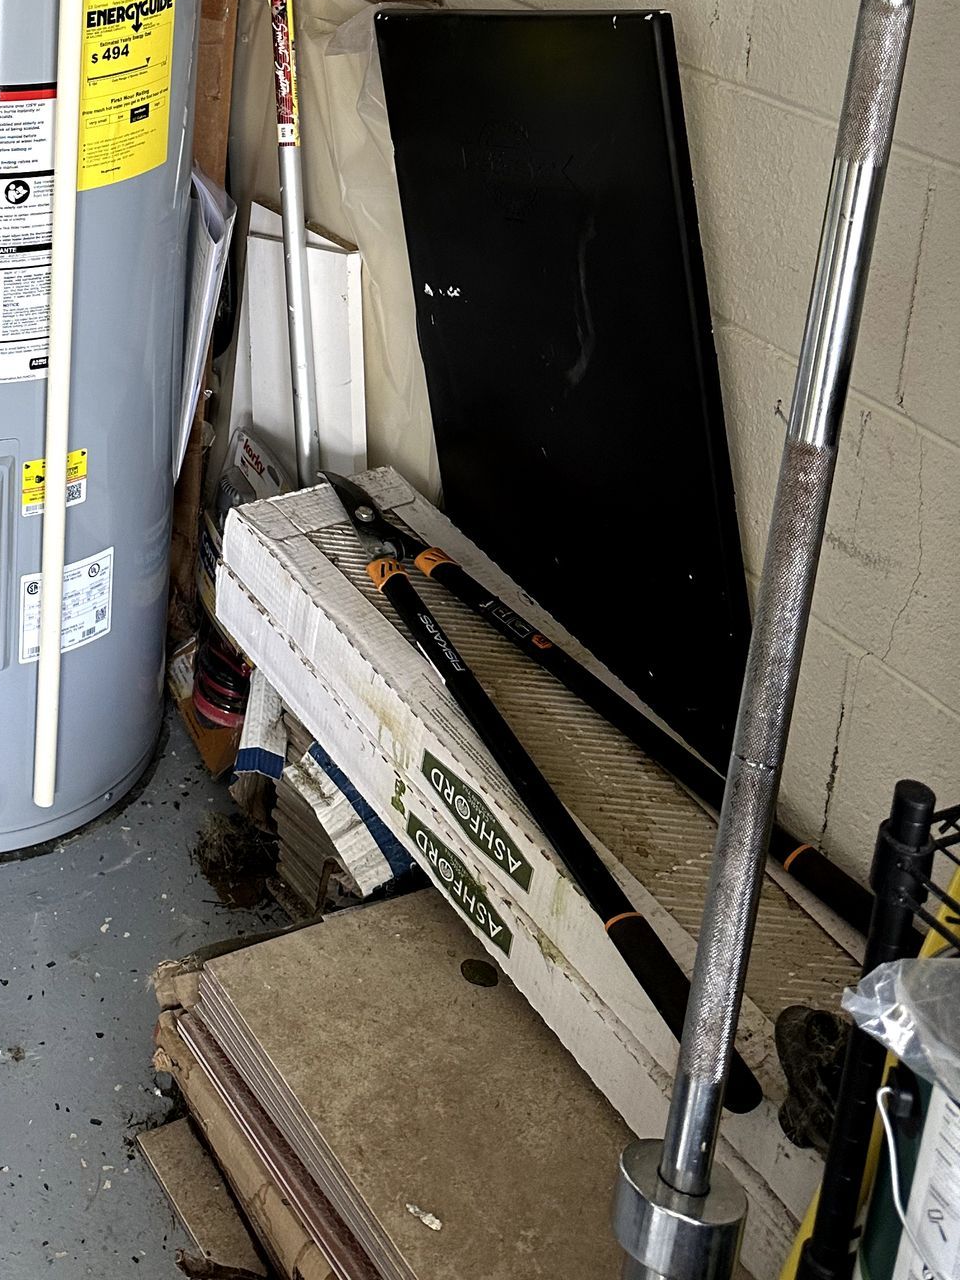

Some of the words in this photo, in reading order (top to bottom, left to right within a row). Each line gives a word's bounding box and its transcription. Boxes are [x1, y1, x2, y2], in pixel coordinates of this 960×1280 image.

[102, 43, 130, 61] 494
[419, 614, 466, 672] FISKARS
[431, 768, 522, 874] ASHFORD
[415, 829, 503, 938] ASHFORD
